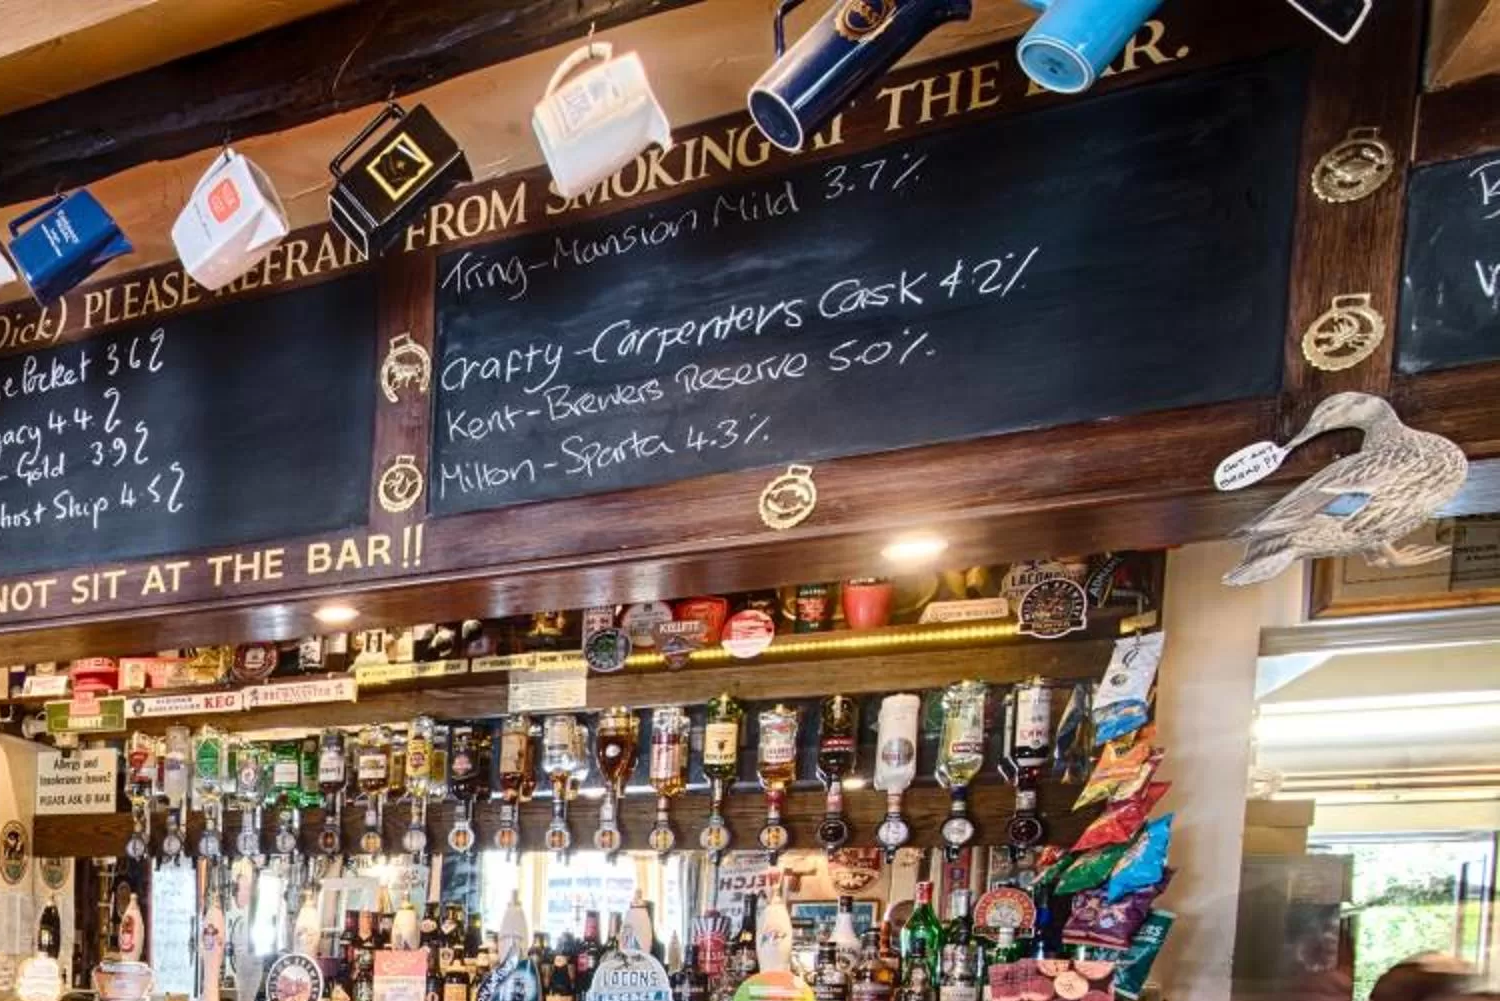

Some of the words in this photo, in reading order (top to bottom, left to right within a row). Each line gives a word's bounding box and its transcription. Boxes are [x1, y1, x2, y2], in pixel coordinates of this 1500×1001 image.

[83, 268, 199, 328] PLEASE
[404, 181, 528, 252] FROM
[872, 62, 1000, 131] THE
[70, 569, 128, 605] SIT
[141, 560, 190, 596] AT
[206, 547, 286, 588] THE
[203, 692, 236, 710] KEG
